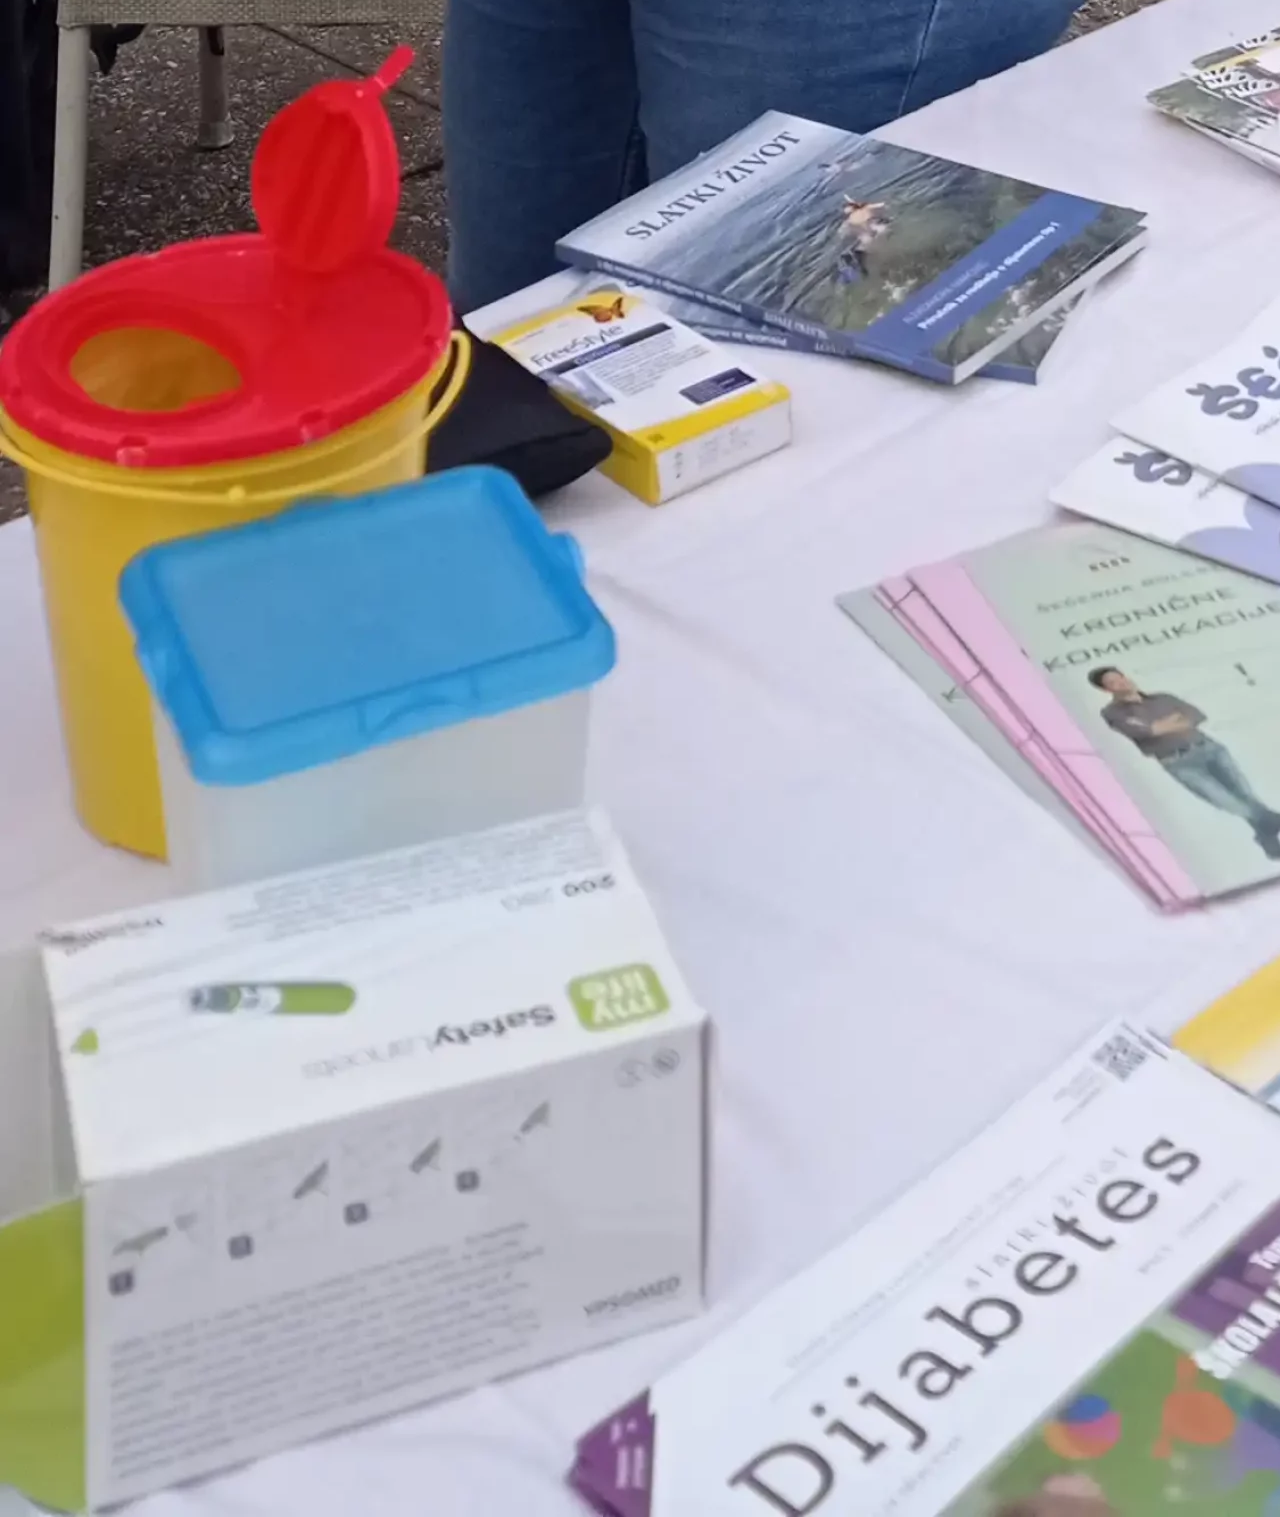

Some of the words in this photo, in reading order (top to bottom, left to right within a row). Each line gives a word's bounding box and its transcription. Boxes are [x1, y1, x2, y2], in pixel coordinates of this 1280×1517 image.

[626, 185, 725, 240] SLATKI
[716, 130, 801, 190] ŽIVOT
[531, 323, 624, 367] FreeStyle
[1060, 586, 1238, 640] KRONIČNE
[727, 1135, 1201, 1517] Dijabetes
